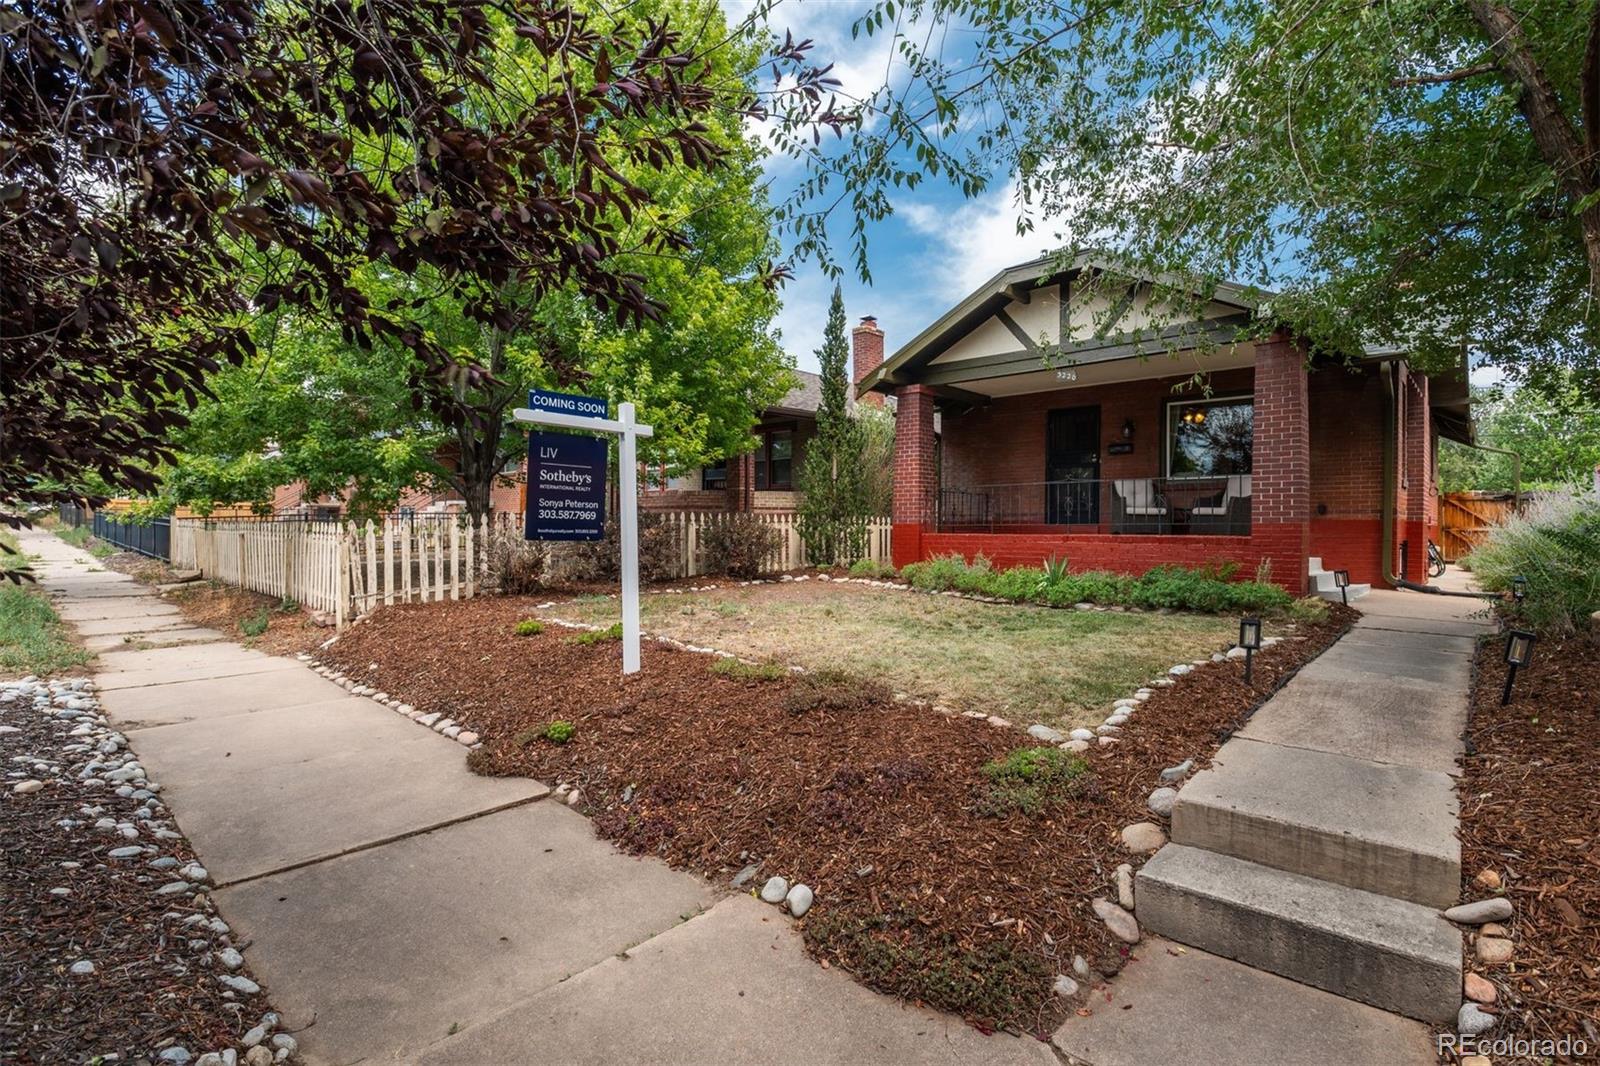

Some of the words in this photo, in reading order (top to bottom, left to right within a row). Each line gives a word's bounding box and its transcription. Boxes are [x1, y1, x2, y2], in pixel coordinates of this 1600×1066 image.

[533, 395, 575, 410] COMING
[577, 402, 606, 415] SOON
[540, 446, 558, 459] LIV
[539, 469, 592, 486] Sotheby's
[538, 498, 564, 509] Sonya
[565, 499, 599, 509] Peterson
[538, 509, 597, 520] 303.587.7969
